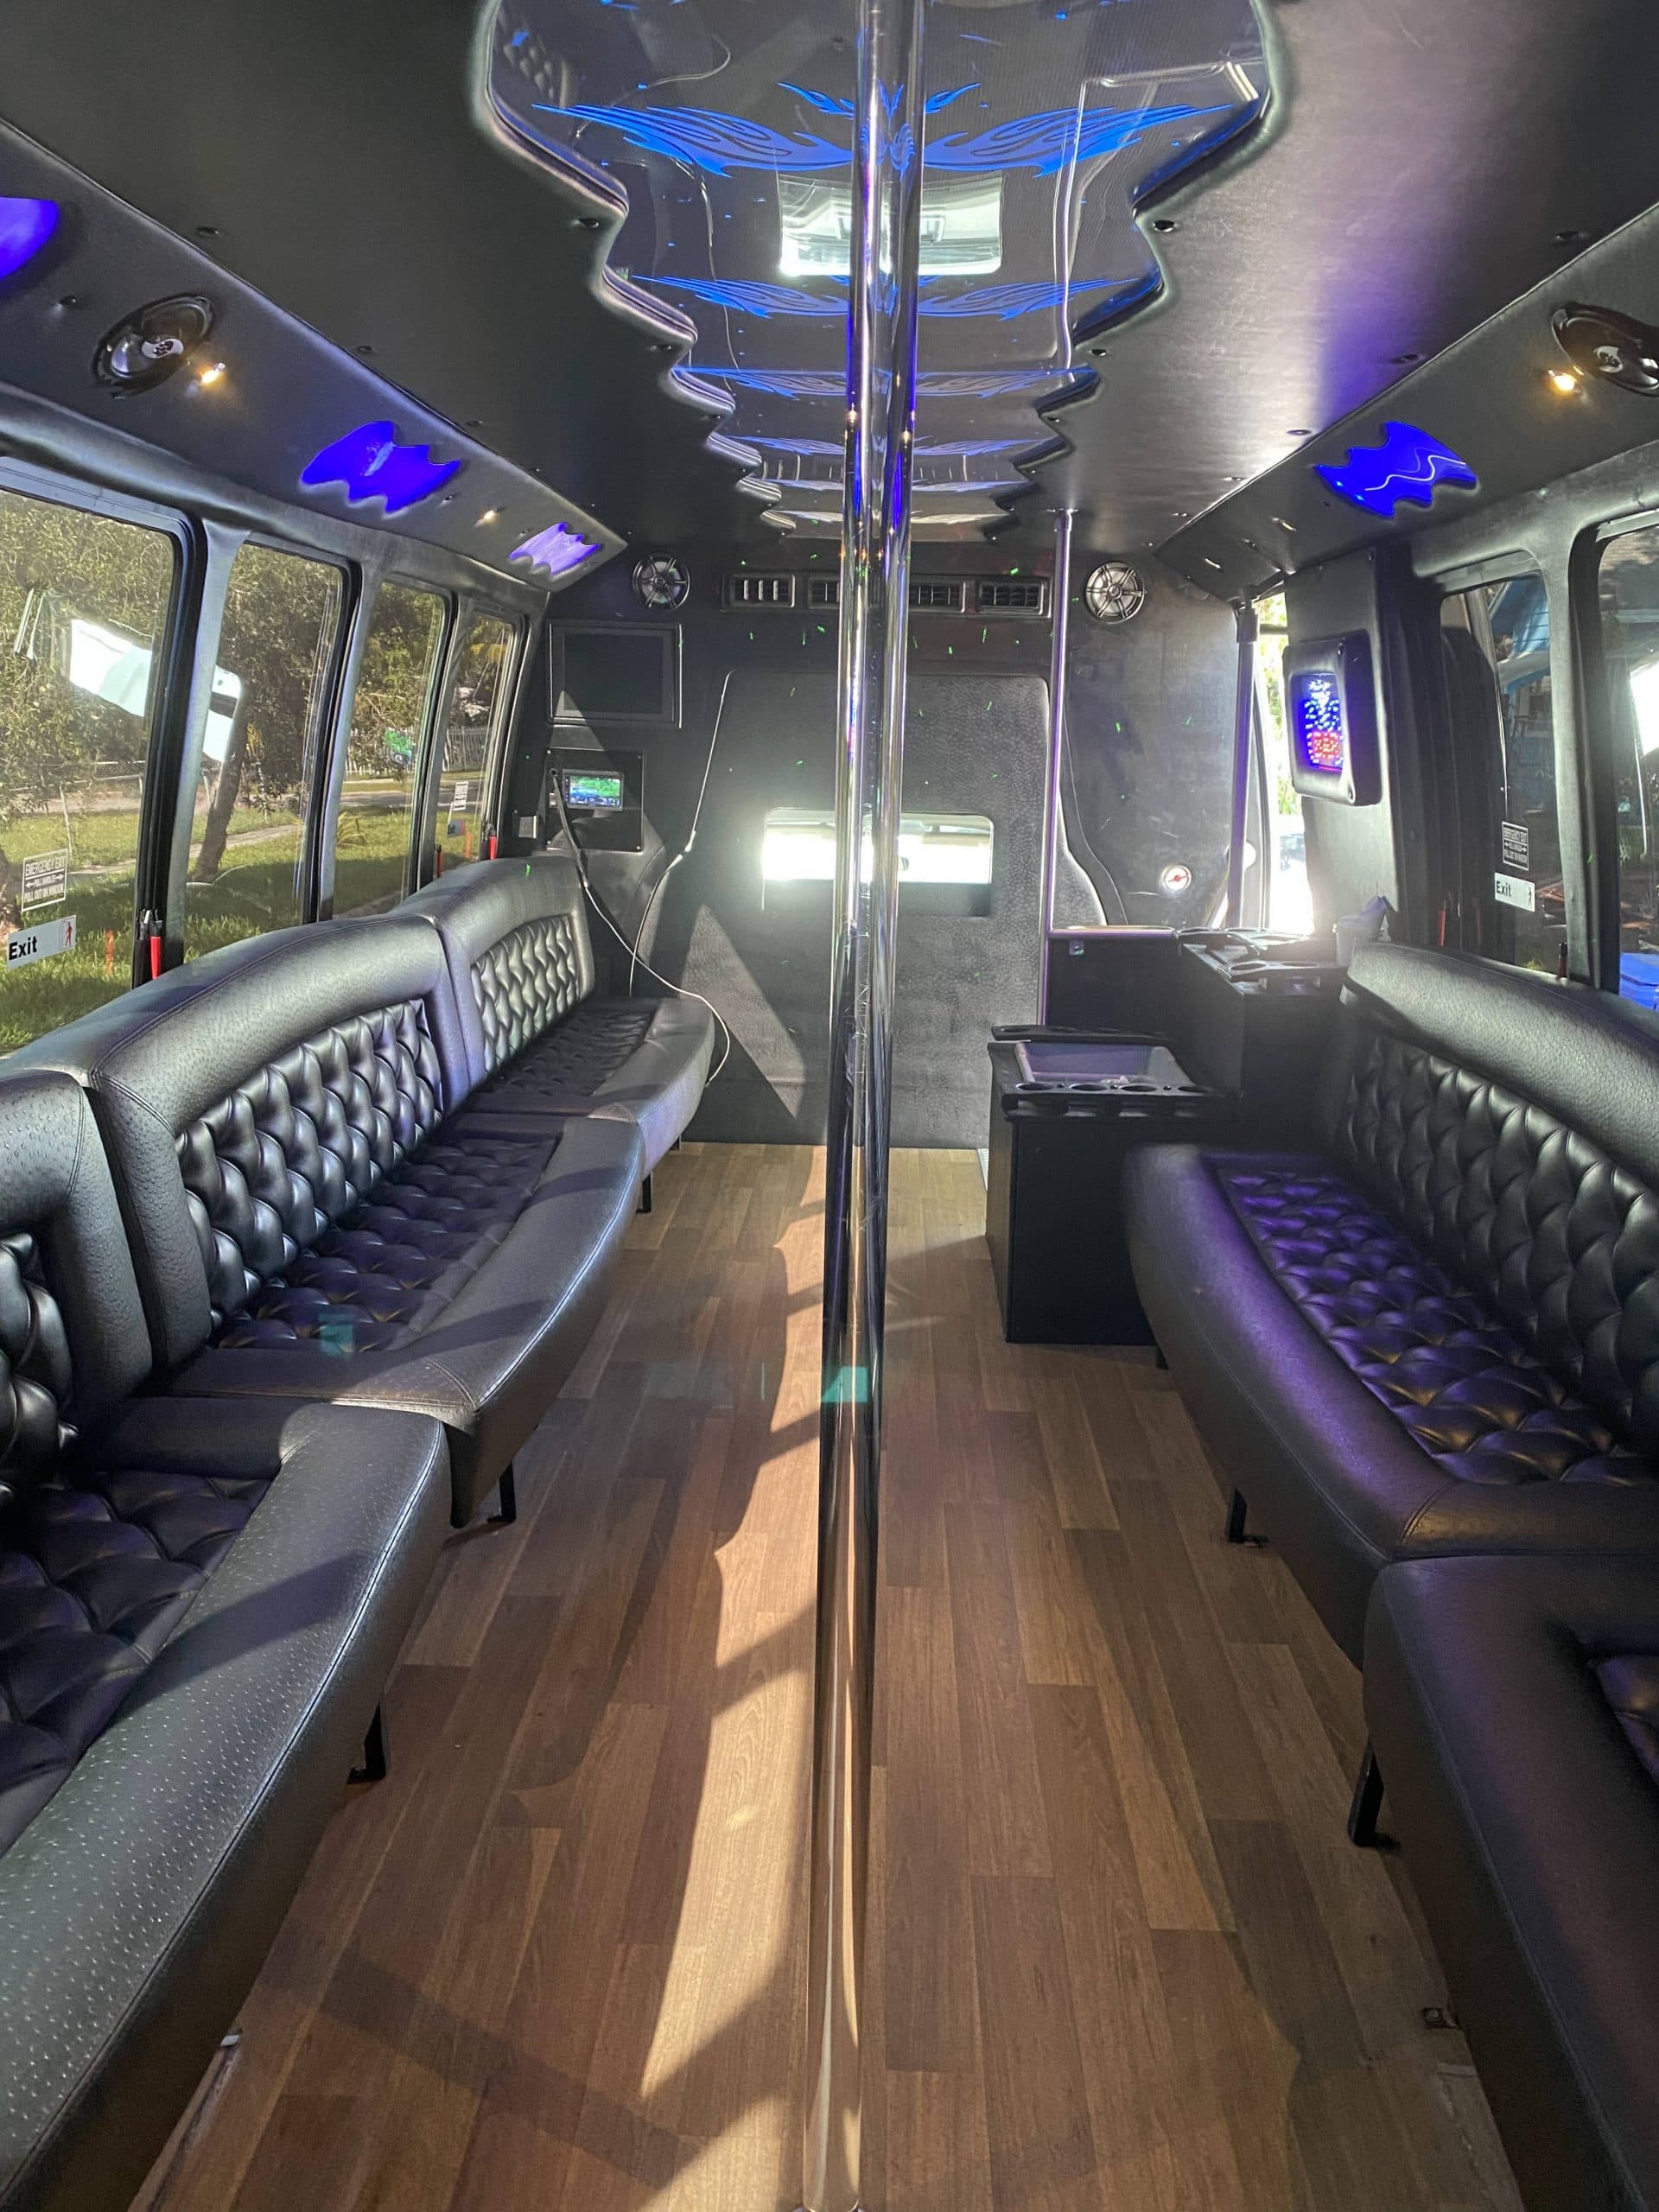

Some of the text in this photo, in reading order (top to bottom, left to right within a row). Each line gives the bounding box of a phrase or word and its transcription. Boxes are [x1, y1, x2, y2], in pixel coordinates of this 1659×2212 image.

[25, 855, 66, 876] EMERGENCY EXIT
[24, 891, 35, 903] PULL
[1497, 880, 1511, 897] Exit
[9, 935, 37, 962] Exit
